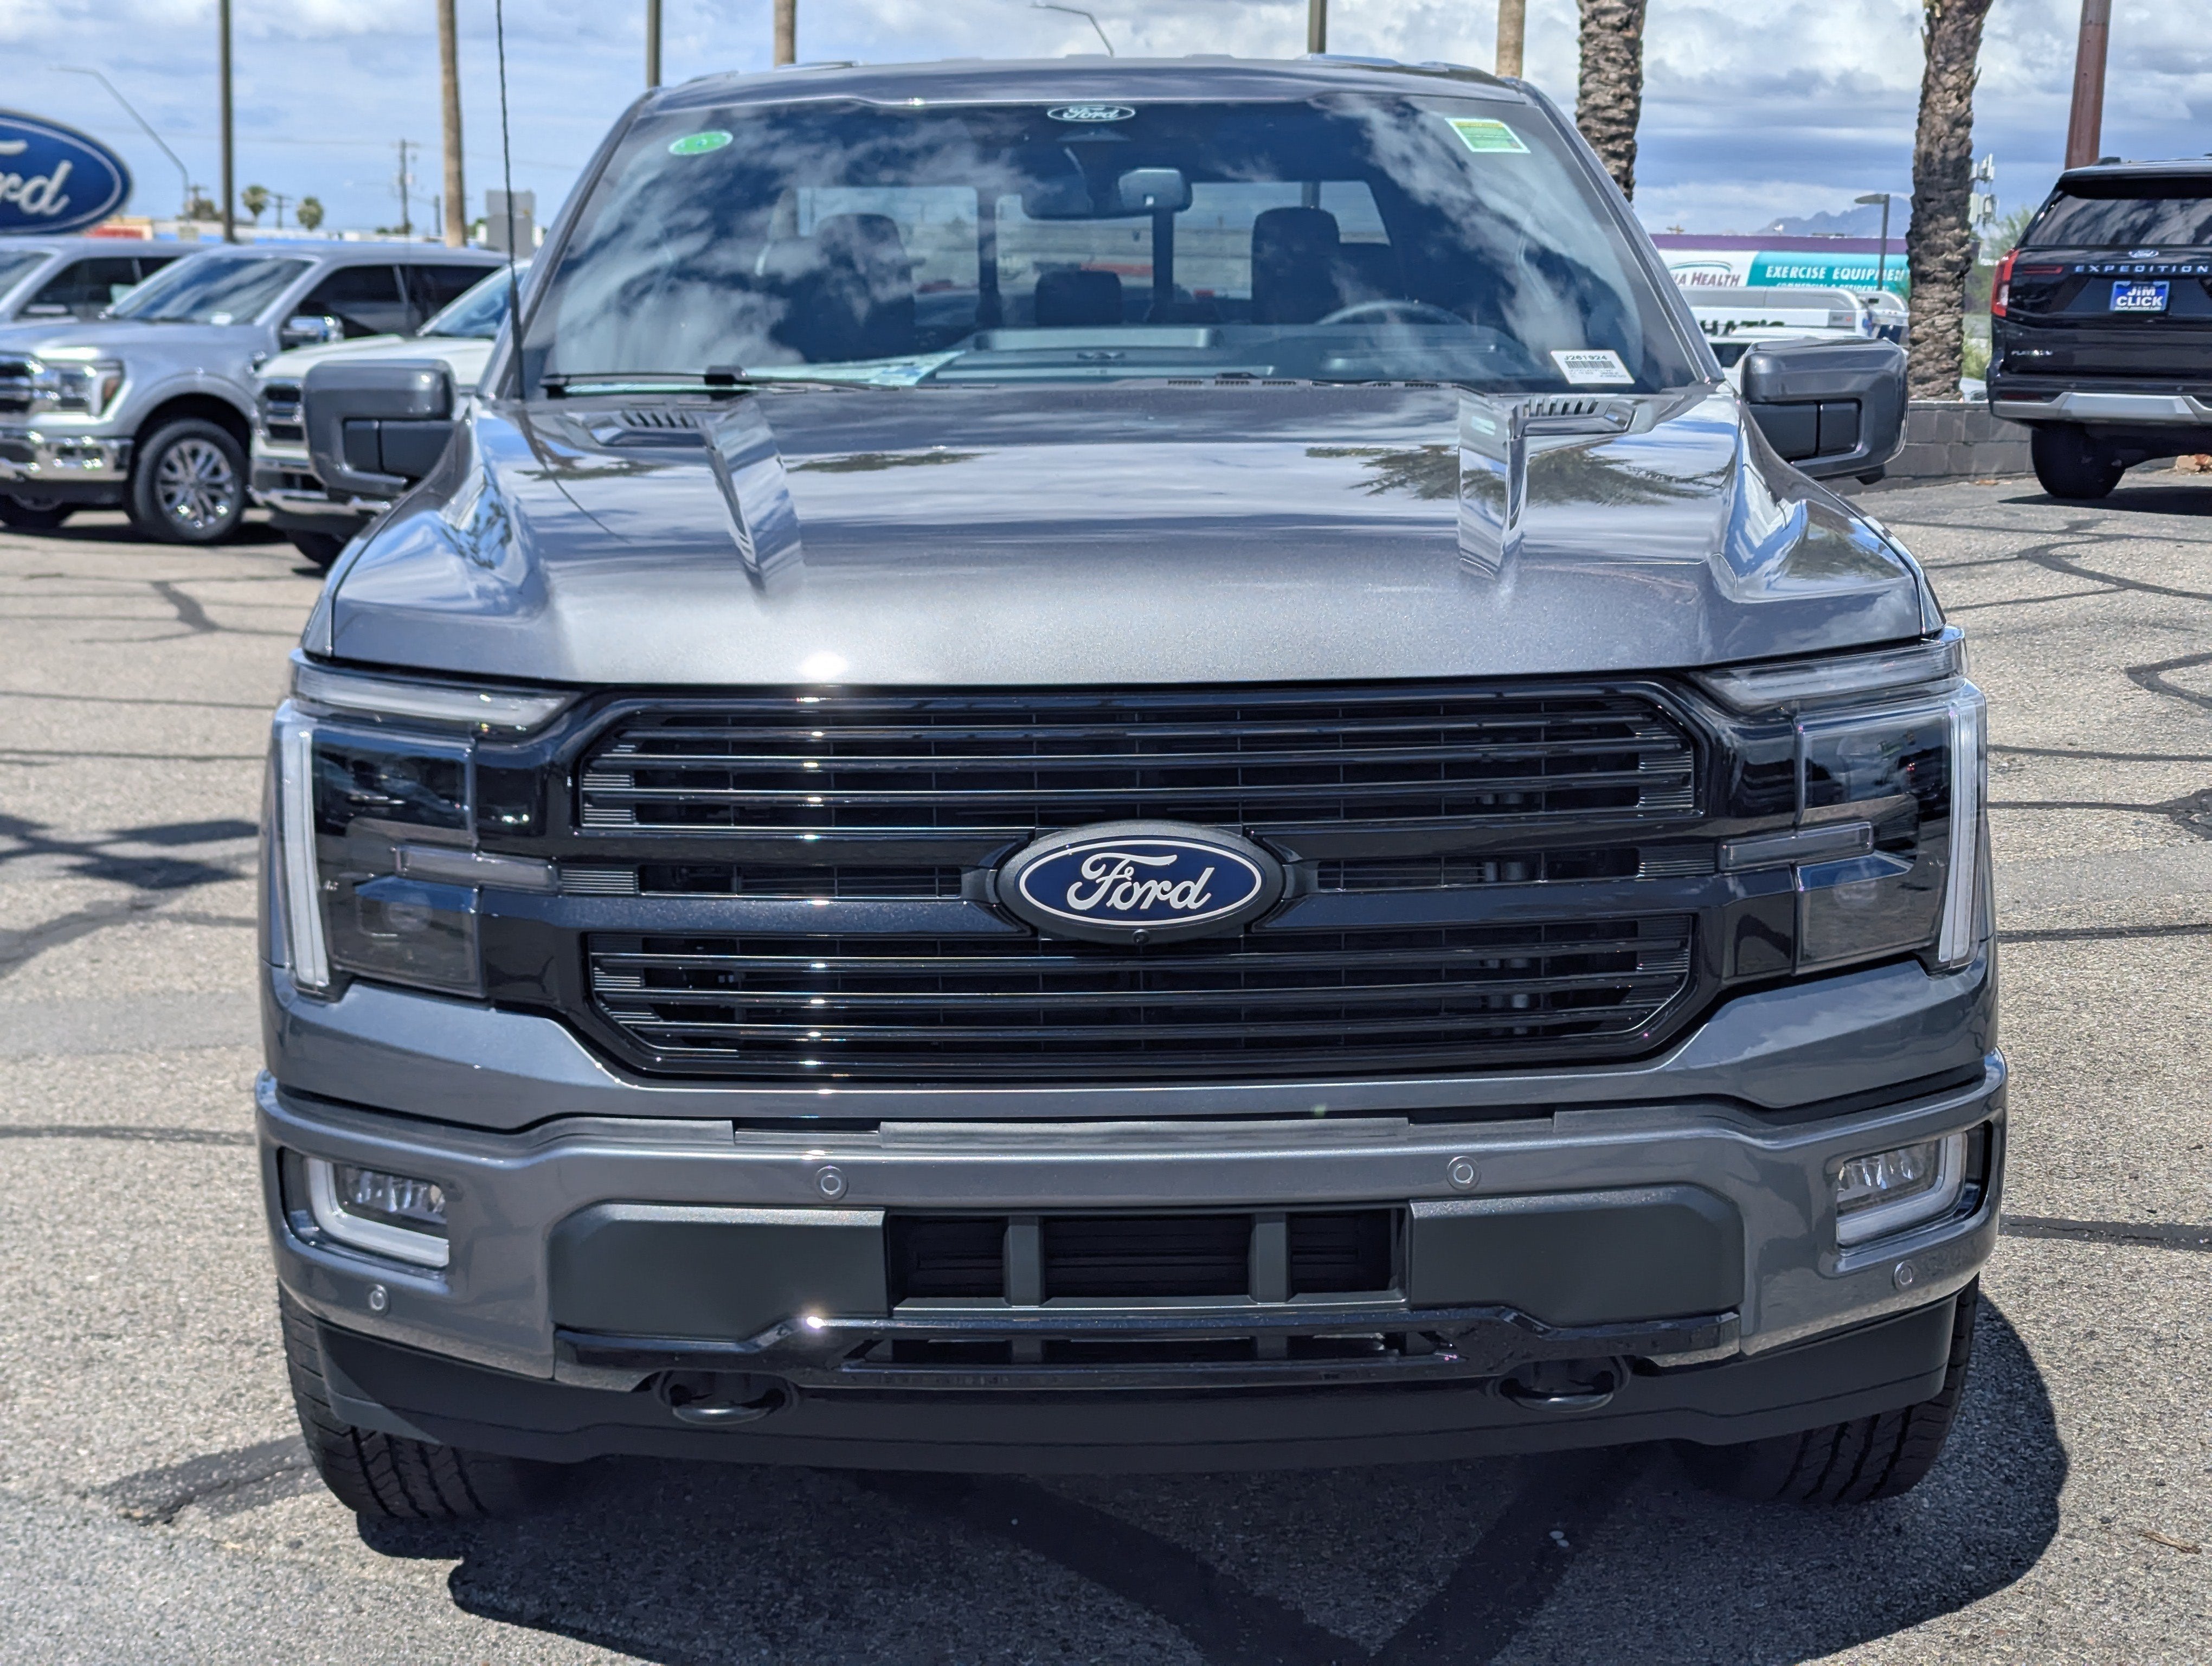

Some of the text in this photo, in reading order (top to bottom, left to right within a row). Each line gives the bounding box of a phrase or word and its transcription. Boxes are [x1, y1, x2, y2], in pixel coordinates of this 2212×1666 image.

[1063, 106, 1120, 119] Ford
[1765, 266, 1827, 279] EXERCISE
[2075, 264, 2209, 272] EXPEDITION
[1690, 272, 1741, 287] HEALTH
[2126, 286, 2156, 296] JIM
[2116, 296, 2164, 306] CLICK
[1066, 852, 1215, 911] Ford
